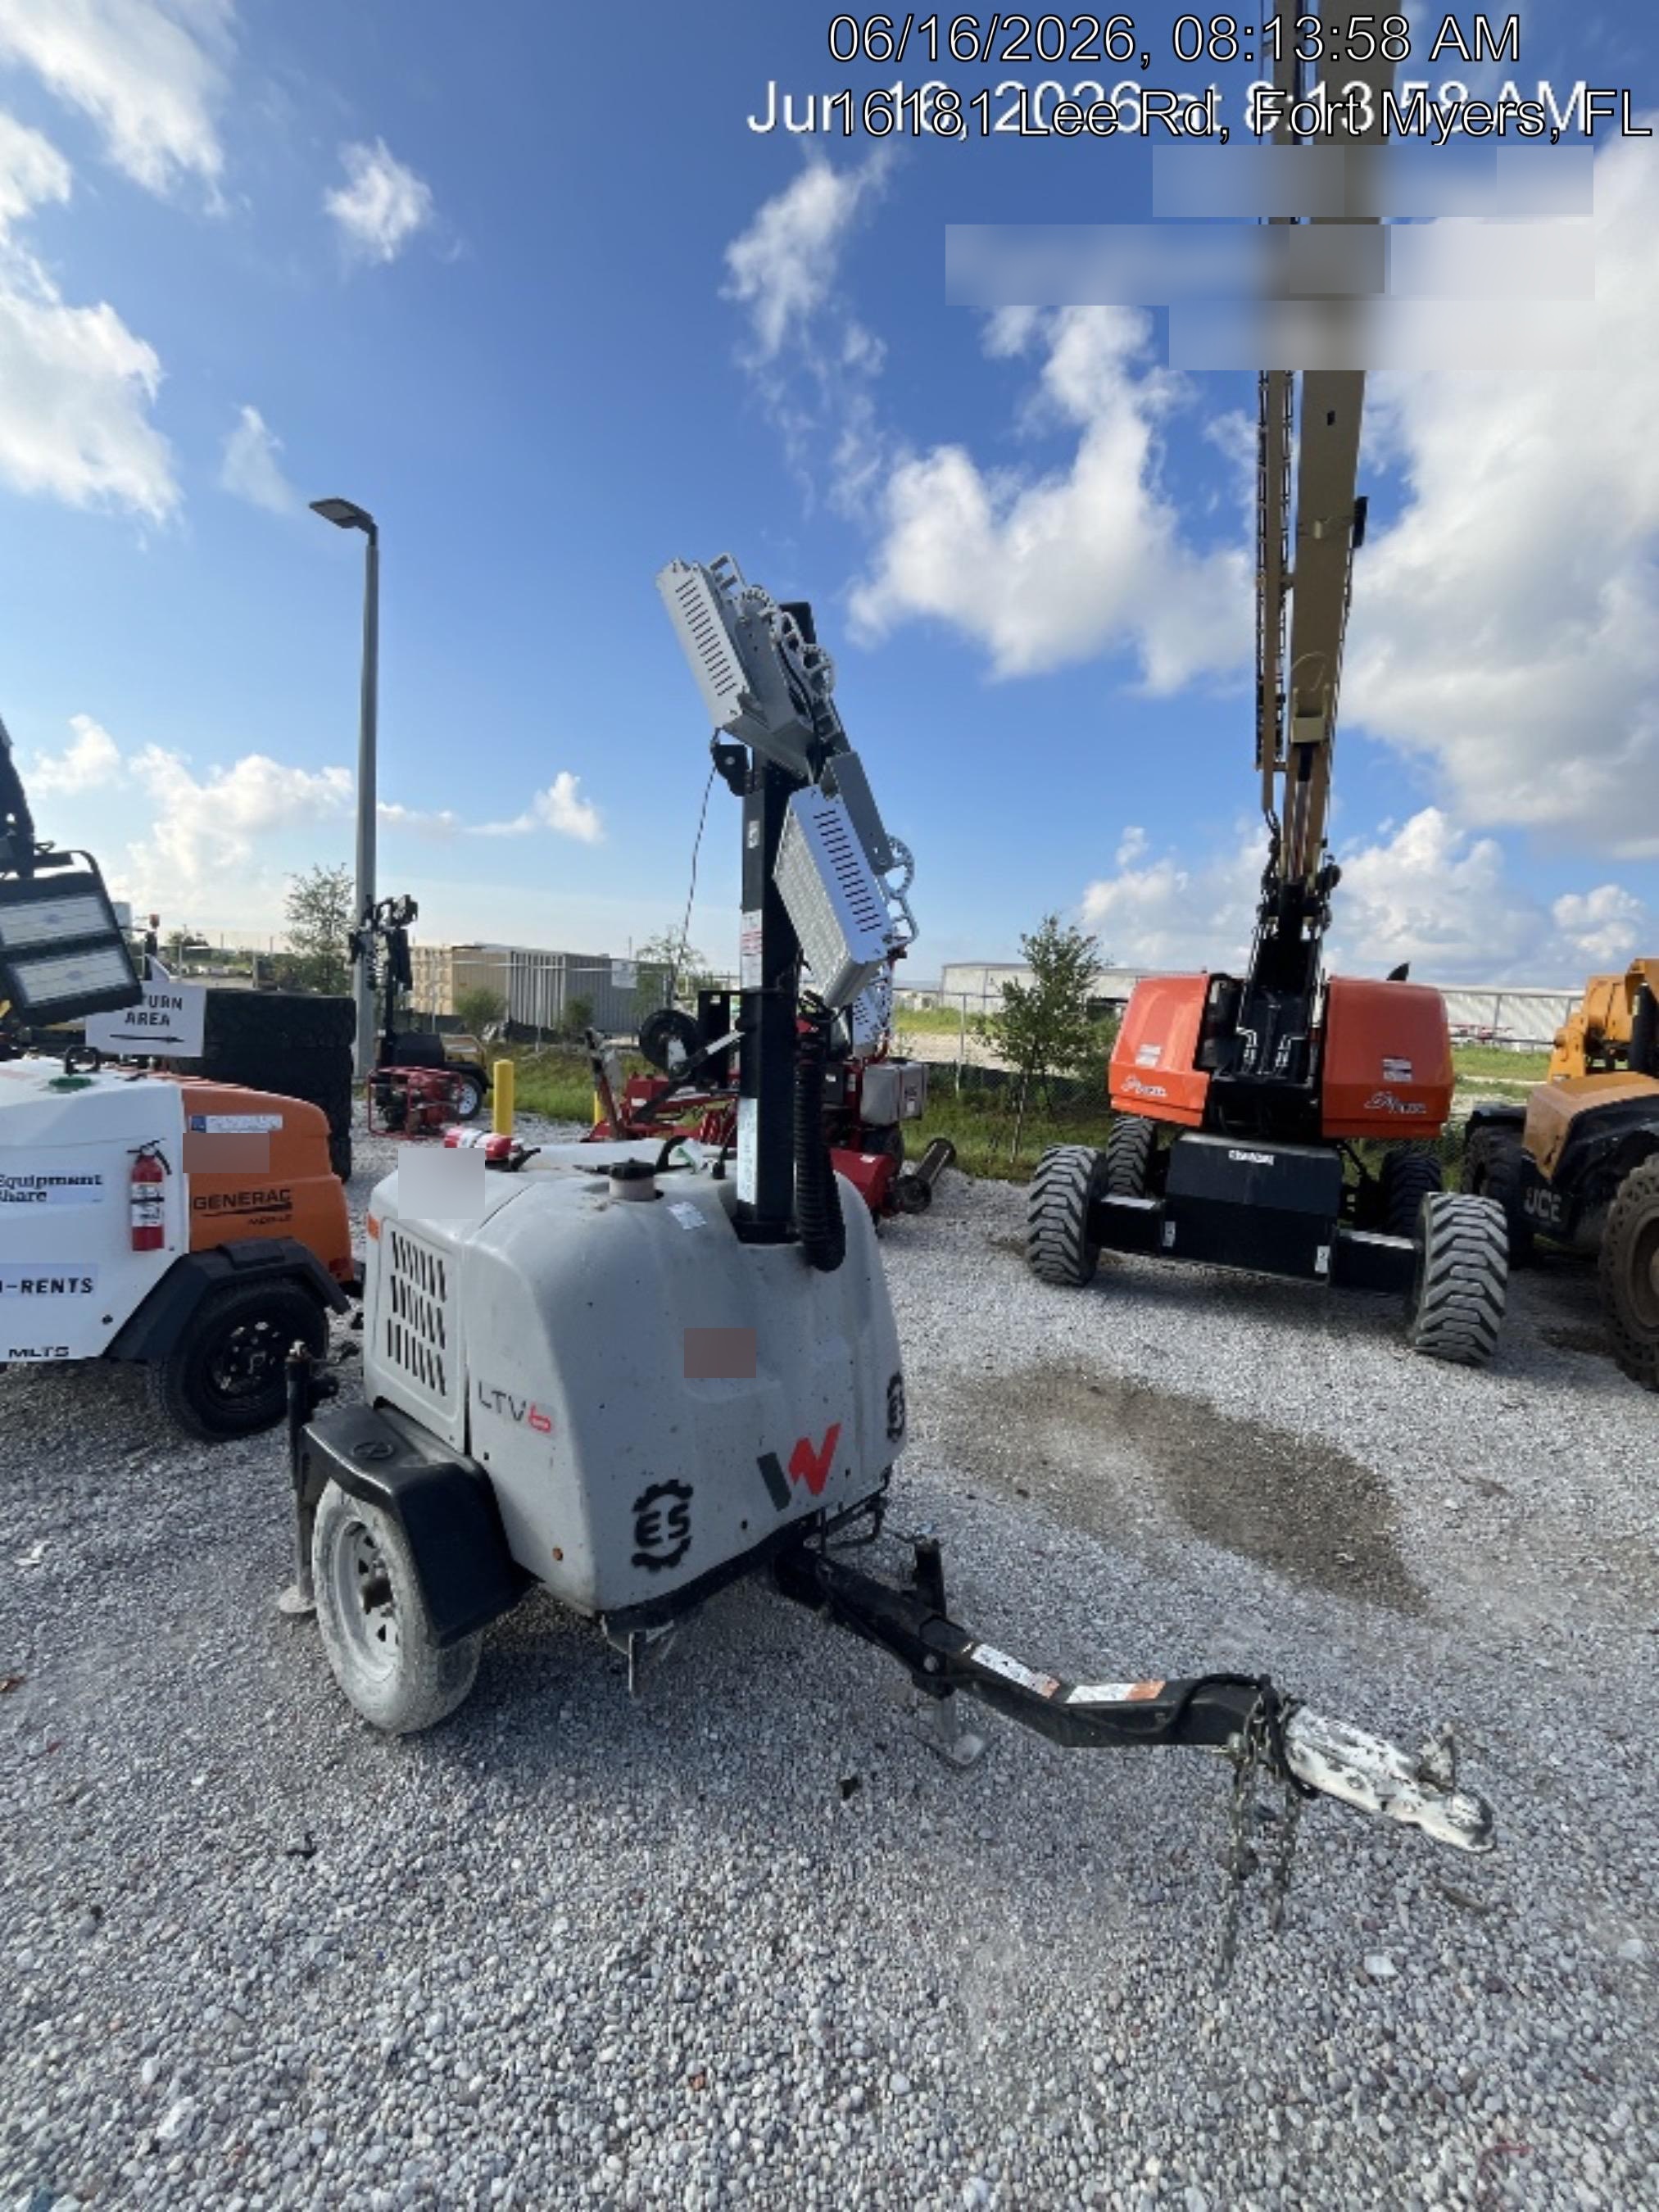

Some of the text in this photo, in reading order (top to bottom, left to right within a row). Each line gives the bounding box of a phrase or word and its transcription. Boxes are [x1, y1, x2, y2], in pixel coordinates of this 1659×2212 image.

[125, 1011, 170, 1027] AREA
[193, 1189, 292, 1210] GENERAC
[478, 1380, 551, 1434] LTV6
[635, 1502, 691, 1548] ES
